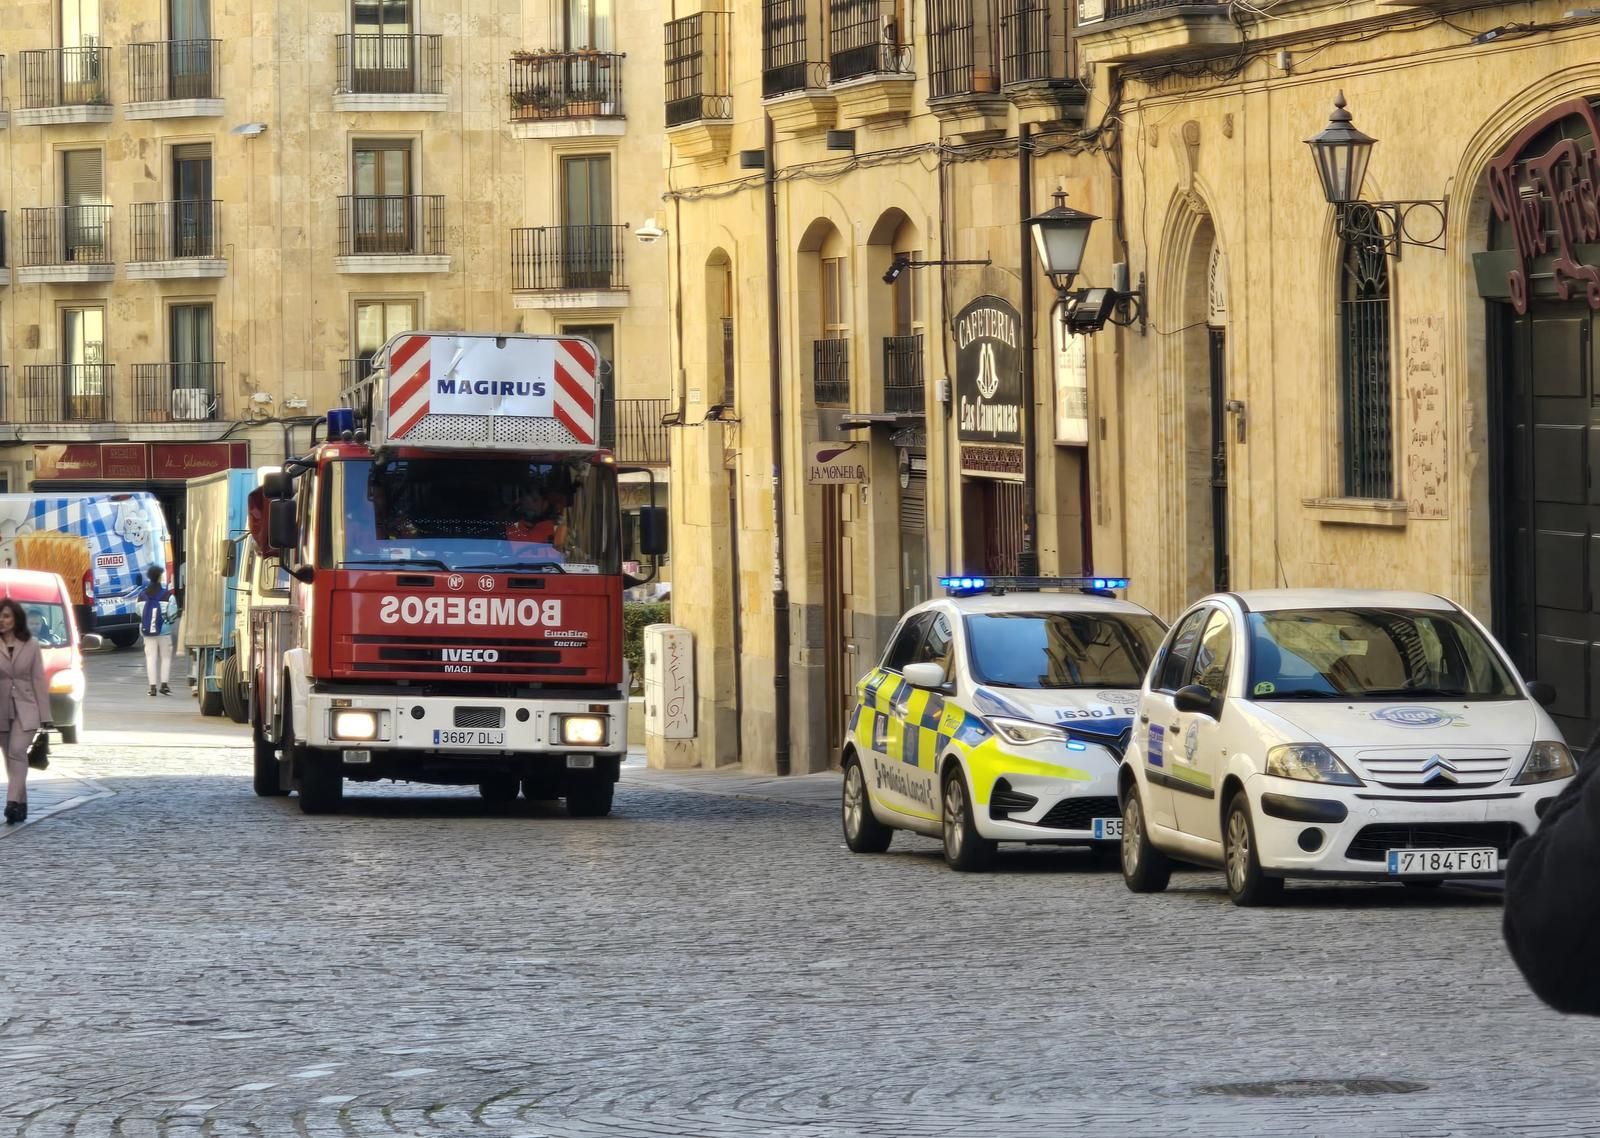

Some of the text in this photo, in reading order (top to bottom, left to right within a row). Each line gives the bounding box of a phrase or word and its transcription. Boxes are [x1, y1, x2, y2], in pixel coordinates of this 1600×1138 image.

[959, 308, 1016, 350] CAFETERIA
[437, 379, 546, 397] MAGIRUS
[961, 395, 975, 431] Las
[976, 395, 1018, 438] Campanas
[97, 555, 124, 566] BIMBO
[480, 578, 492, 588] 16
[441, 648, 499, 663] IVECO
[444, 665, 472, 673] MAGI
[442, 731, 474, 744] 3687
